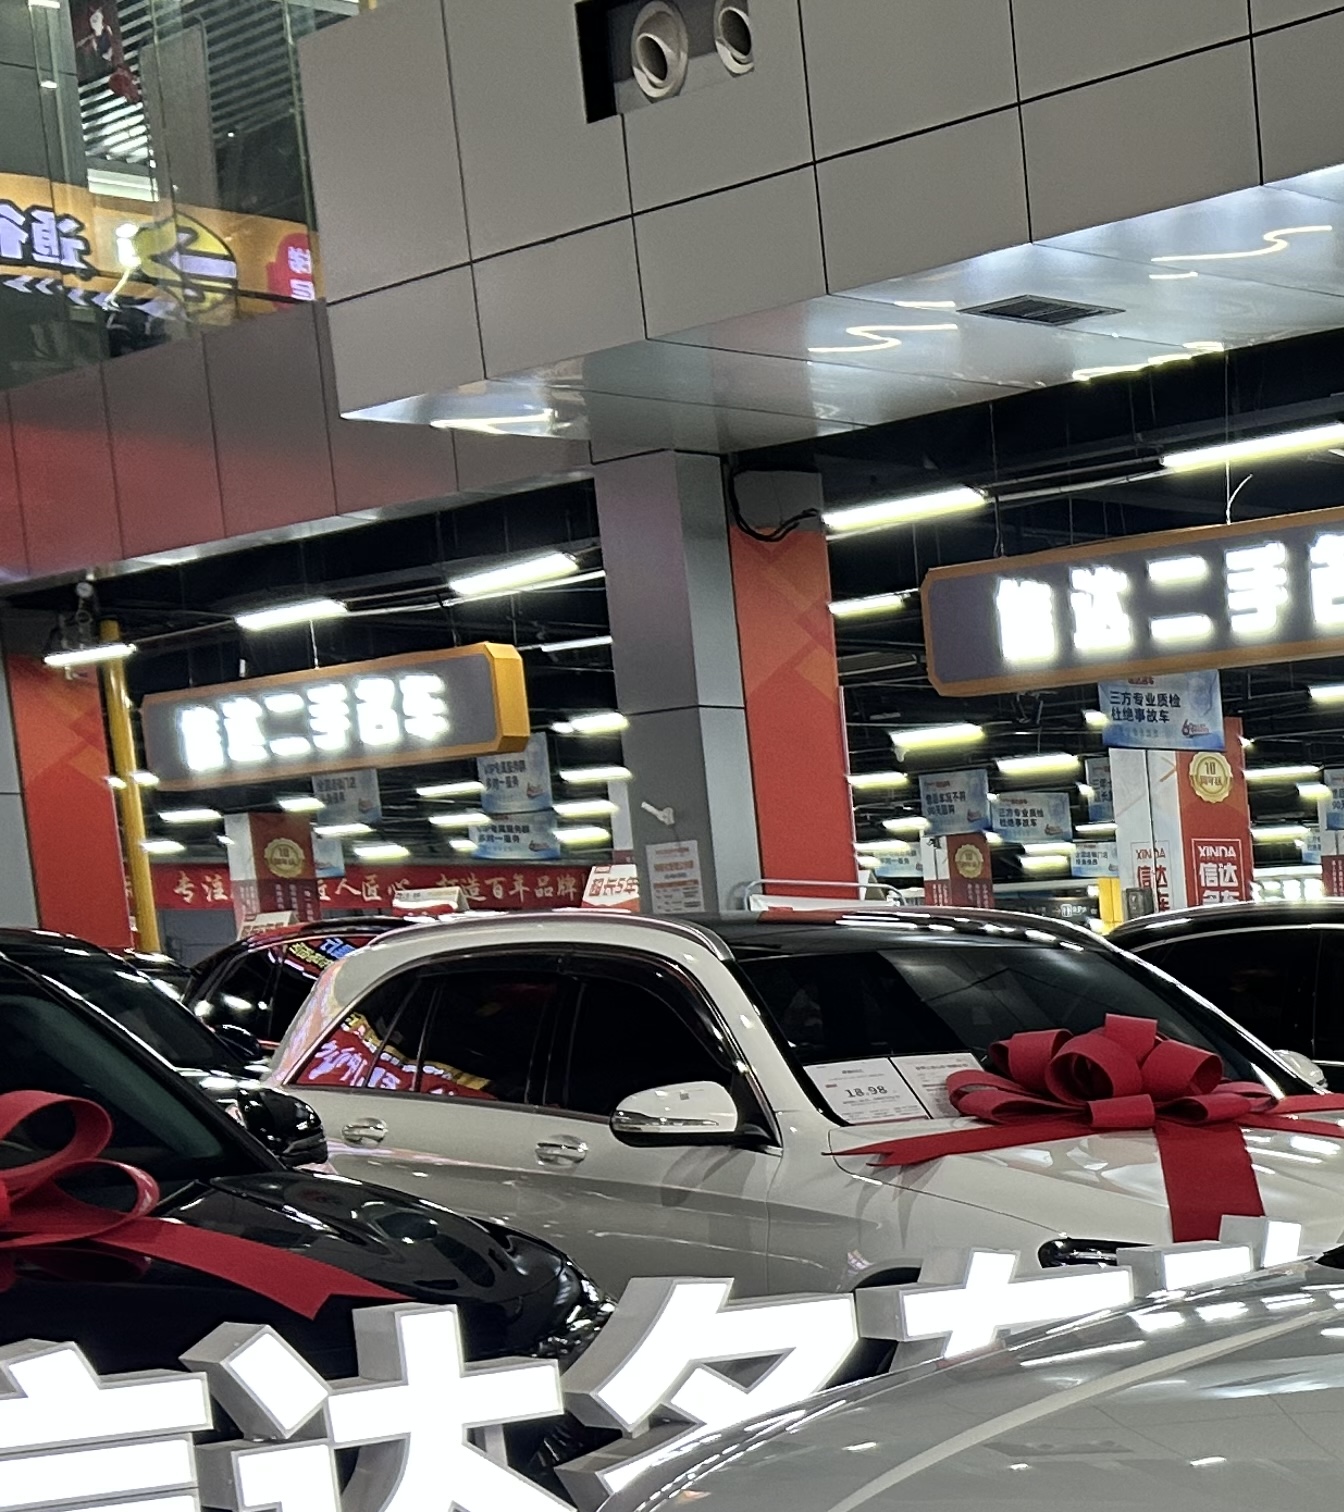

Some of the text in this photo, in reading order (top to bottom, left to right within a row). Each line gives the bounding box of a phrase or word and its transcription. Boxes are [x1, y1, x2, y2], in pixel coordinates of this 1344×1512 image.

[1109, 690, 1181, 709] 三方专业质检
[1111, 707, 1170, 723] 杜绝事故车
[1197, 845, 1237, 858] XINDA
[1199, 862, 1239, 888] 信达
[844, 1084, 888, 1099] 18.98
